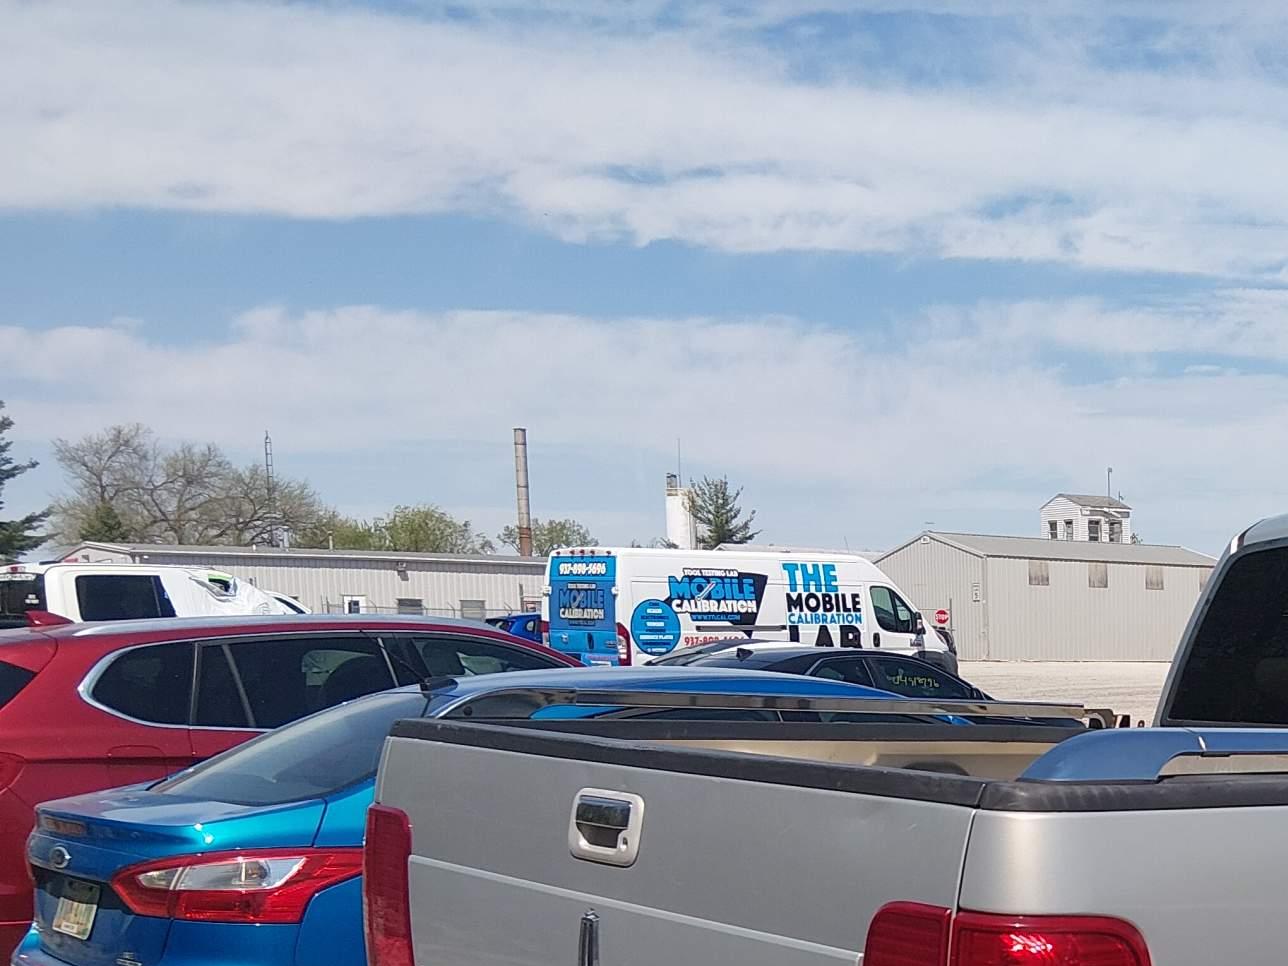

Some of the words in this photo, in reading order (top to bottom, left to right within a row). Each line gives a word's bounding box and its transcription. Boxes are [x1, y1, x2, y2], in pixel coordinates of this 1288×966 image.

[782, 562, 839, 593] THE
[668, 576, 756, 600] MOBILE
[559, 588, 605, 609] MOBILE
[671, 599, 757, 613] CALIBRATION
[786, 592, 862, 613] MOBILE
[559, 607, 605, 620] CALIBRATION
[788, 613, 863, 625] CALIBRATION
[935, 613, 948, 621] STOP
